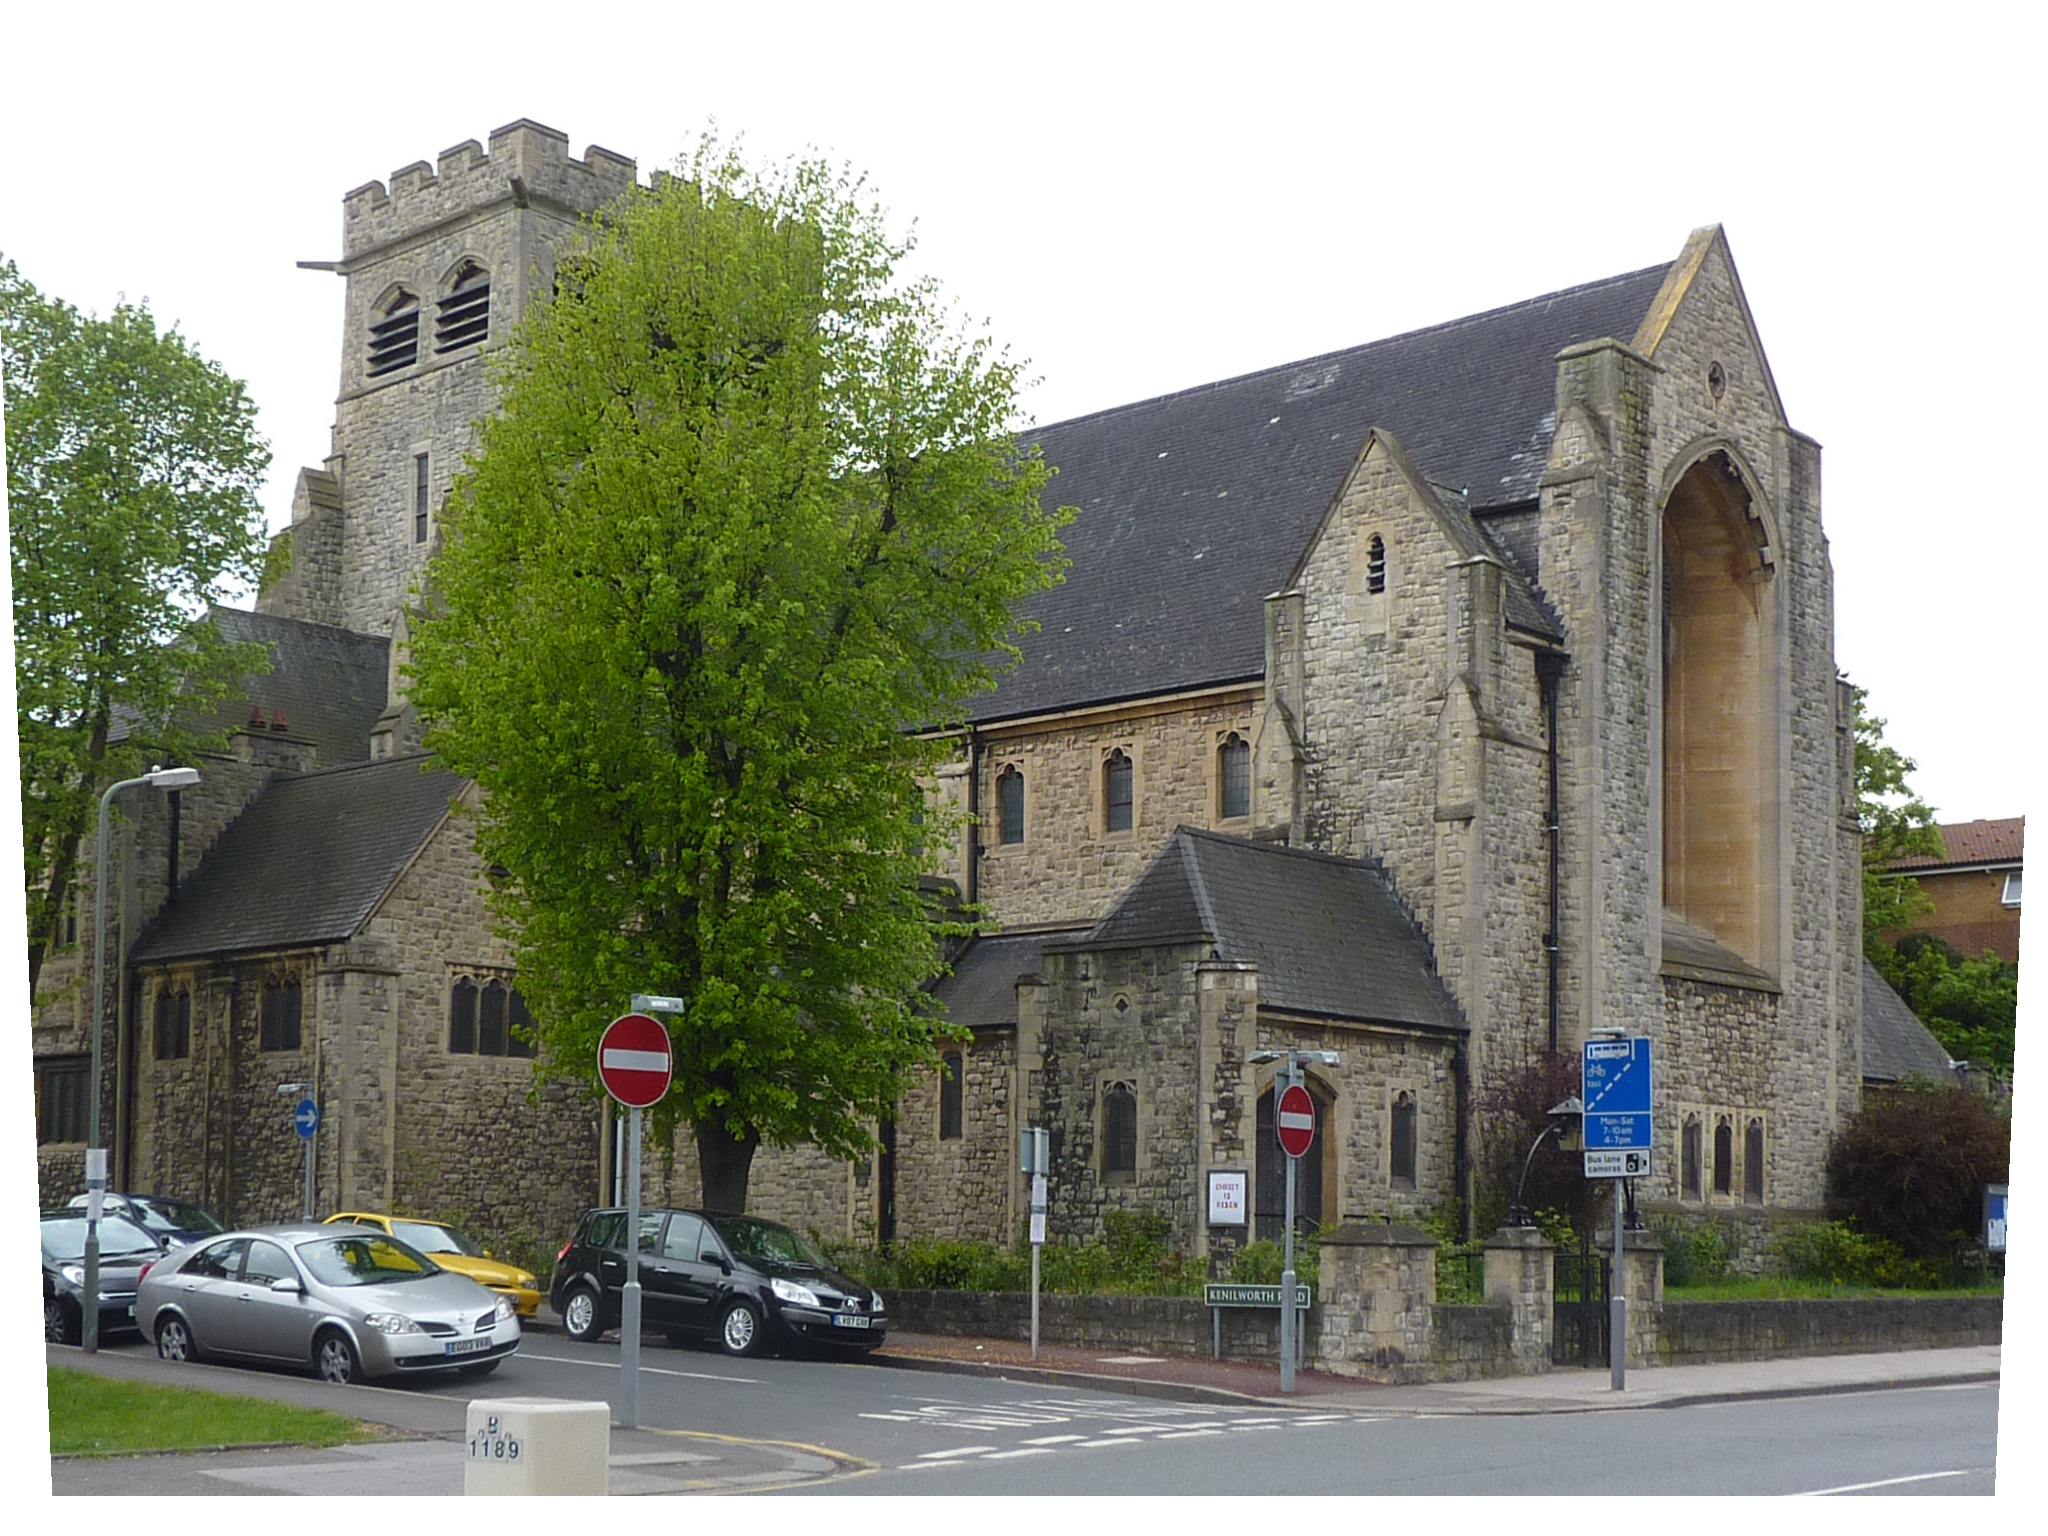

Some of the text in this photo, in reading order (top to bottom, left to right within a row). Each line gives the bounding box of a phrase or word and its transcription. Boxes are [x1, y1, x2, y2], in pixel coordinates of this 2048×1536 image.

[1587, 1080, 1601, 1088] taxi
[1587, 1154, 1621, 1164] Bus lane
[1588, 1165, 1621, 1173] cameras
[1215, 1183, 1239, 1191] CHRIST
[1223, 1192, 1231, 1200] IS
[1216, 1201, 1239, 1209] RISEN
[1209, 1289, 1274, 1303] KENILWORTH
[470, 1439, 519, 1459] 1189
